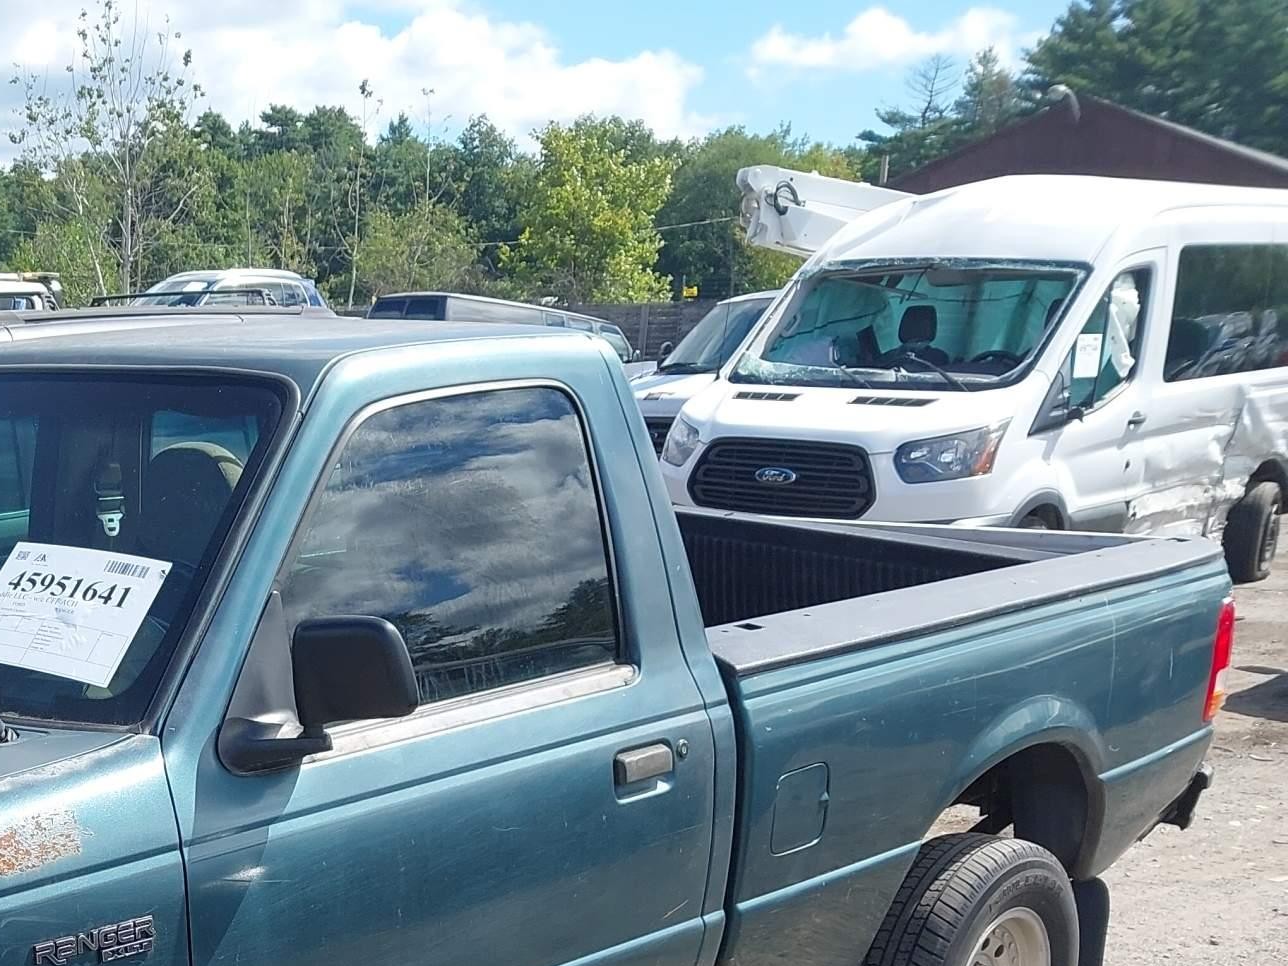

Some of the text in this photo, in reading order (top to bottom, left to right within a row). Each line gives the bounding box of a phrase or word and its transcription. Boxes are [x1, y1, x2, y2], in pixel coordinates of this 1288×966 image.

[760, 469, 791, 482] Ford
[7, 570, 132, 609] 45951641
[33, 914, 156, 966] RANGER
[103, 938, 152, 961] XLT
